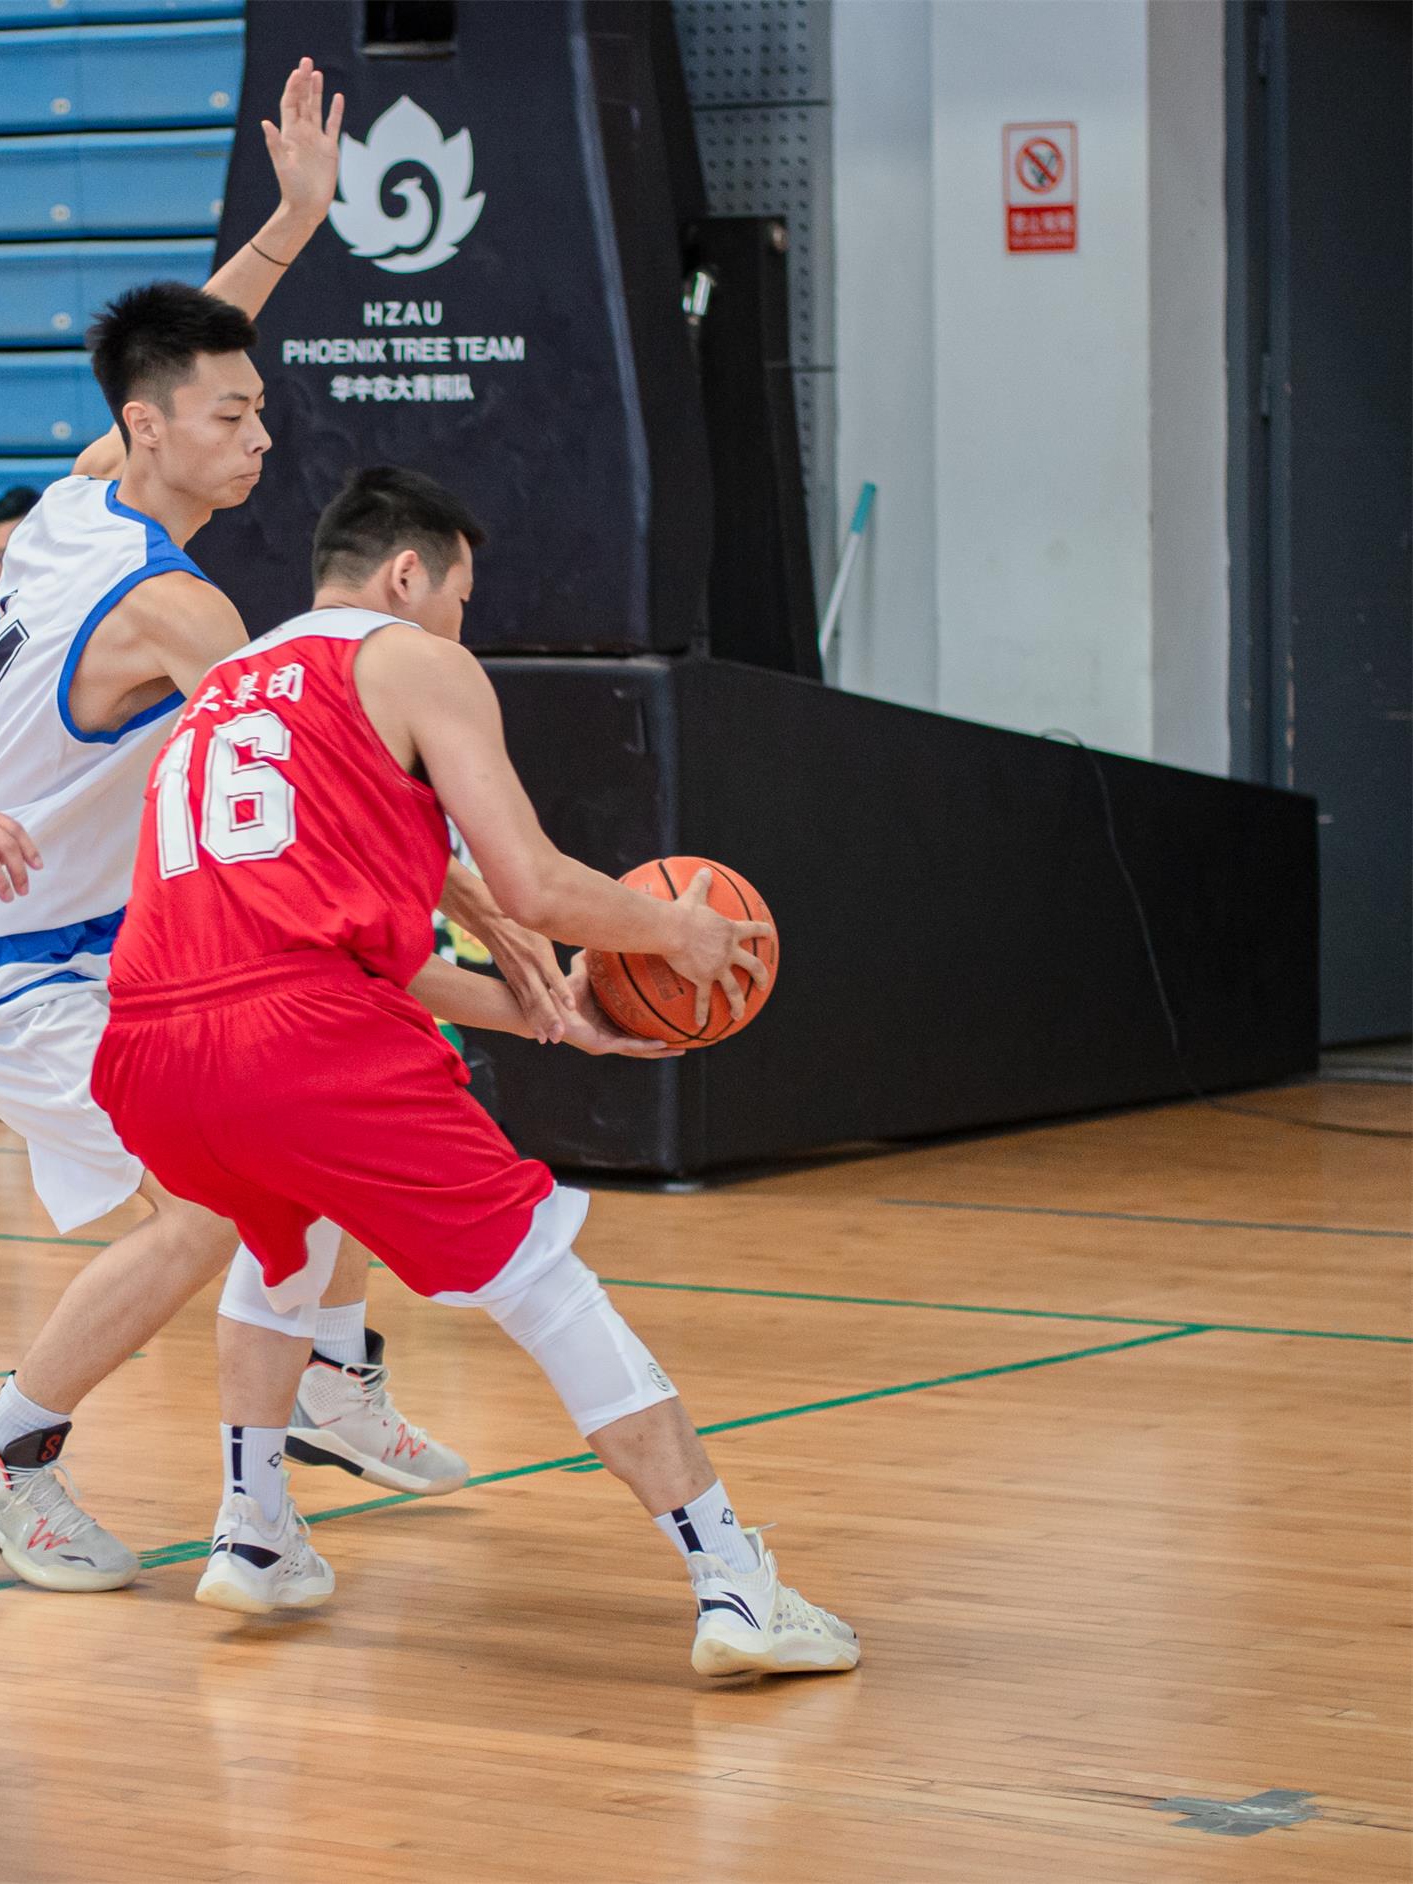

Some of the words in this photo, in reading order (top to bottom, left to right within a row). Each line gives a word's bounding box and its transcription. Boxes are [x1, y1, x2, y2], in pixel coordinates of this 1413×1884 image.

[363, 301, 443, 327] HZAU
[283, 339, 387, 364] PHOENIX
[389, 337, 451, 362] TREE
[454, 336, 525, 361] TEAM
[153, 709, 296, 880] 16
